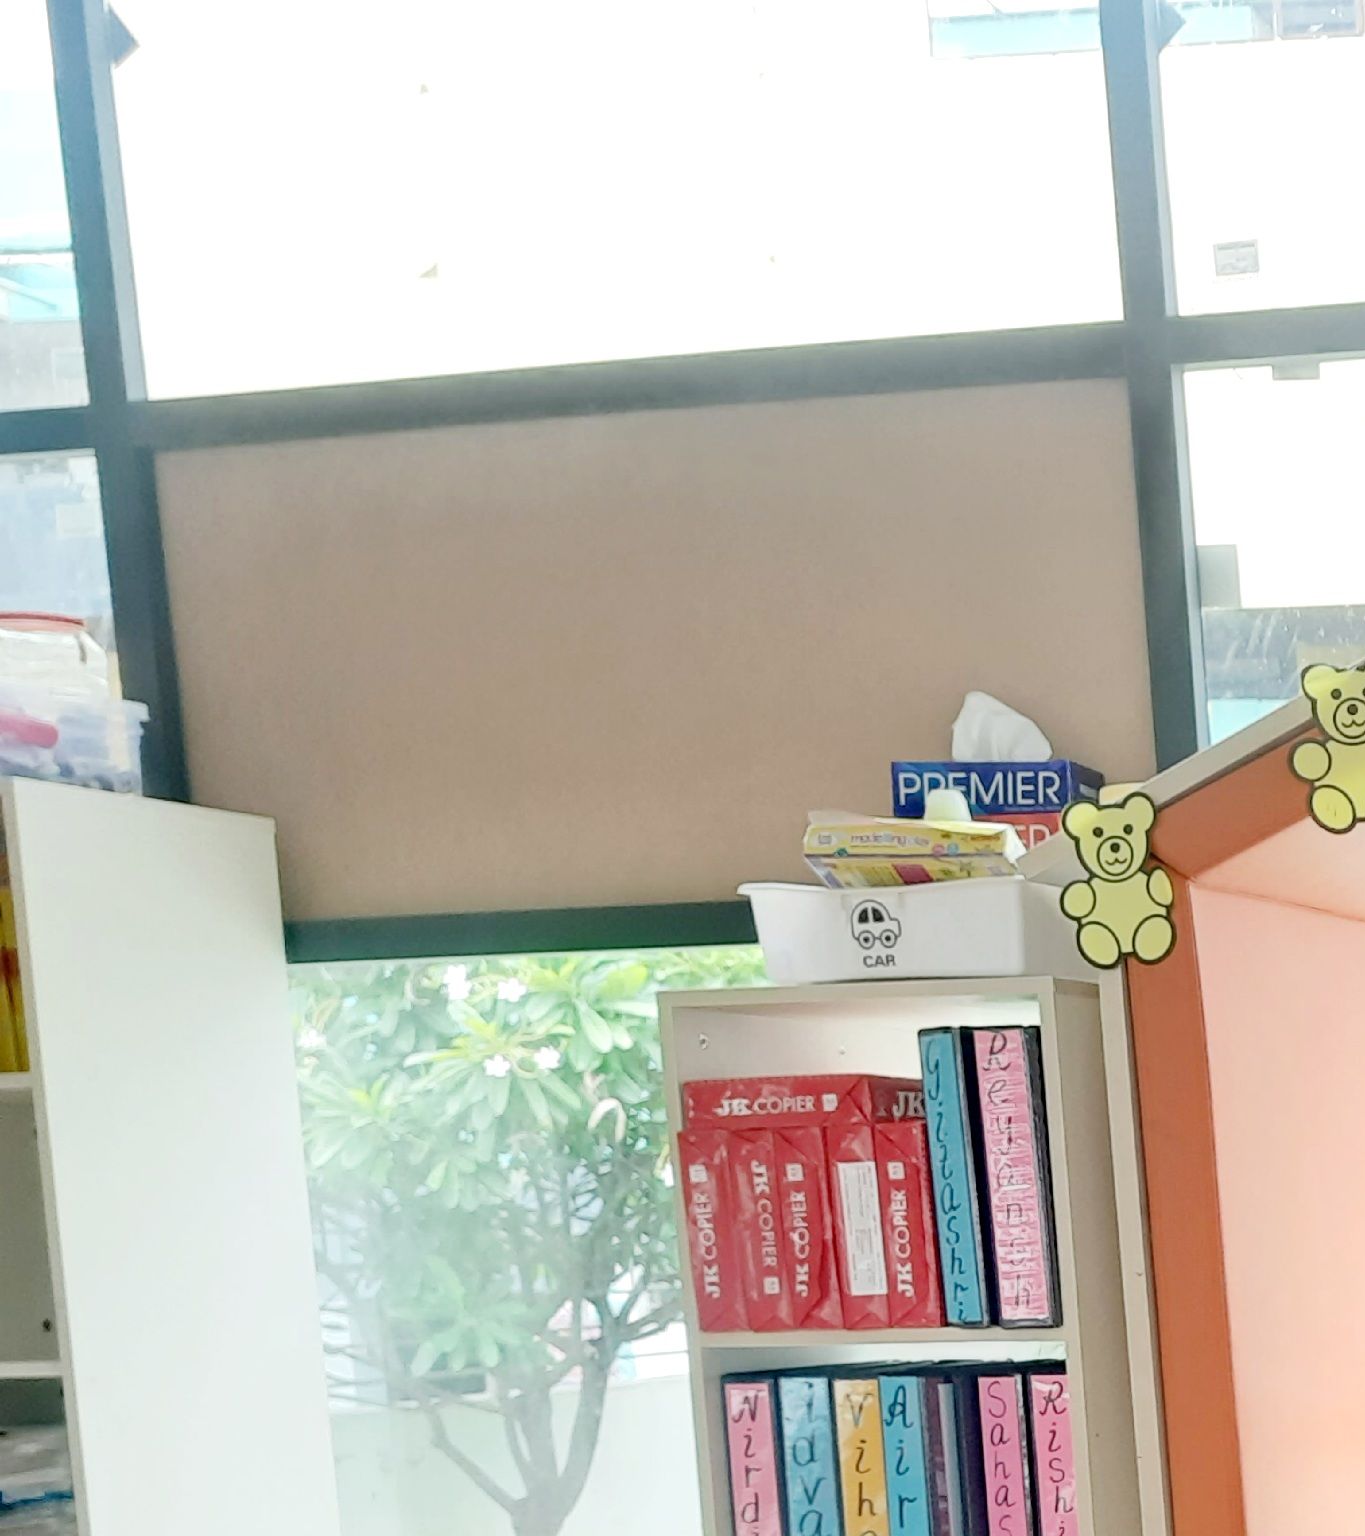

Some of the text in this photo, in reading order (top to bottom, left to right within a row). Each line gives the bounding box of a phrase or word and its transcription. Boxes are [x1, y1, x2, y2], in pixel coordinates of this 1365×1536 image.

[898, 771, 1061, 806] PREMIER
[863, 954, 897, 969] CAR
[753, 1095, 816, 1114] COPIER
[695, 1192, 720, 1299] JK COPIER
[751, 1159, 778, 1267] JK COPIER
[791, 1191, 811, 1297] JK COPIER
[891, 1189, 914, 1298] JK COPIER
